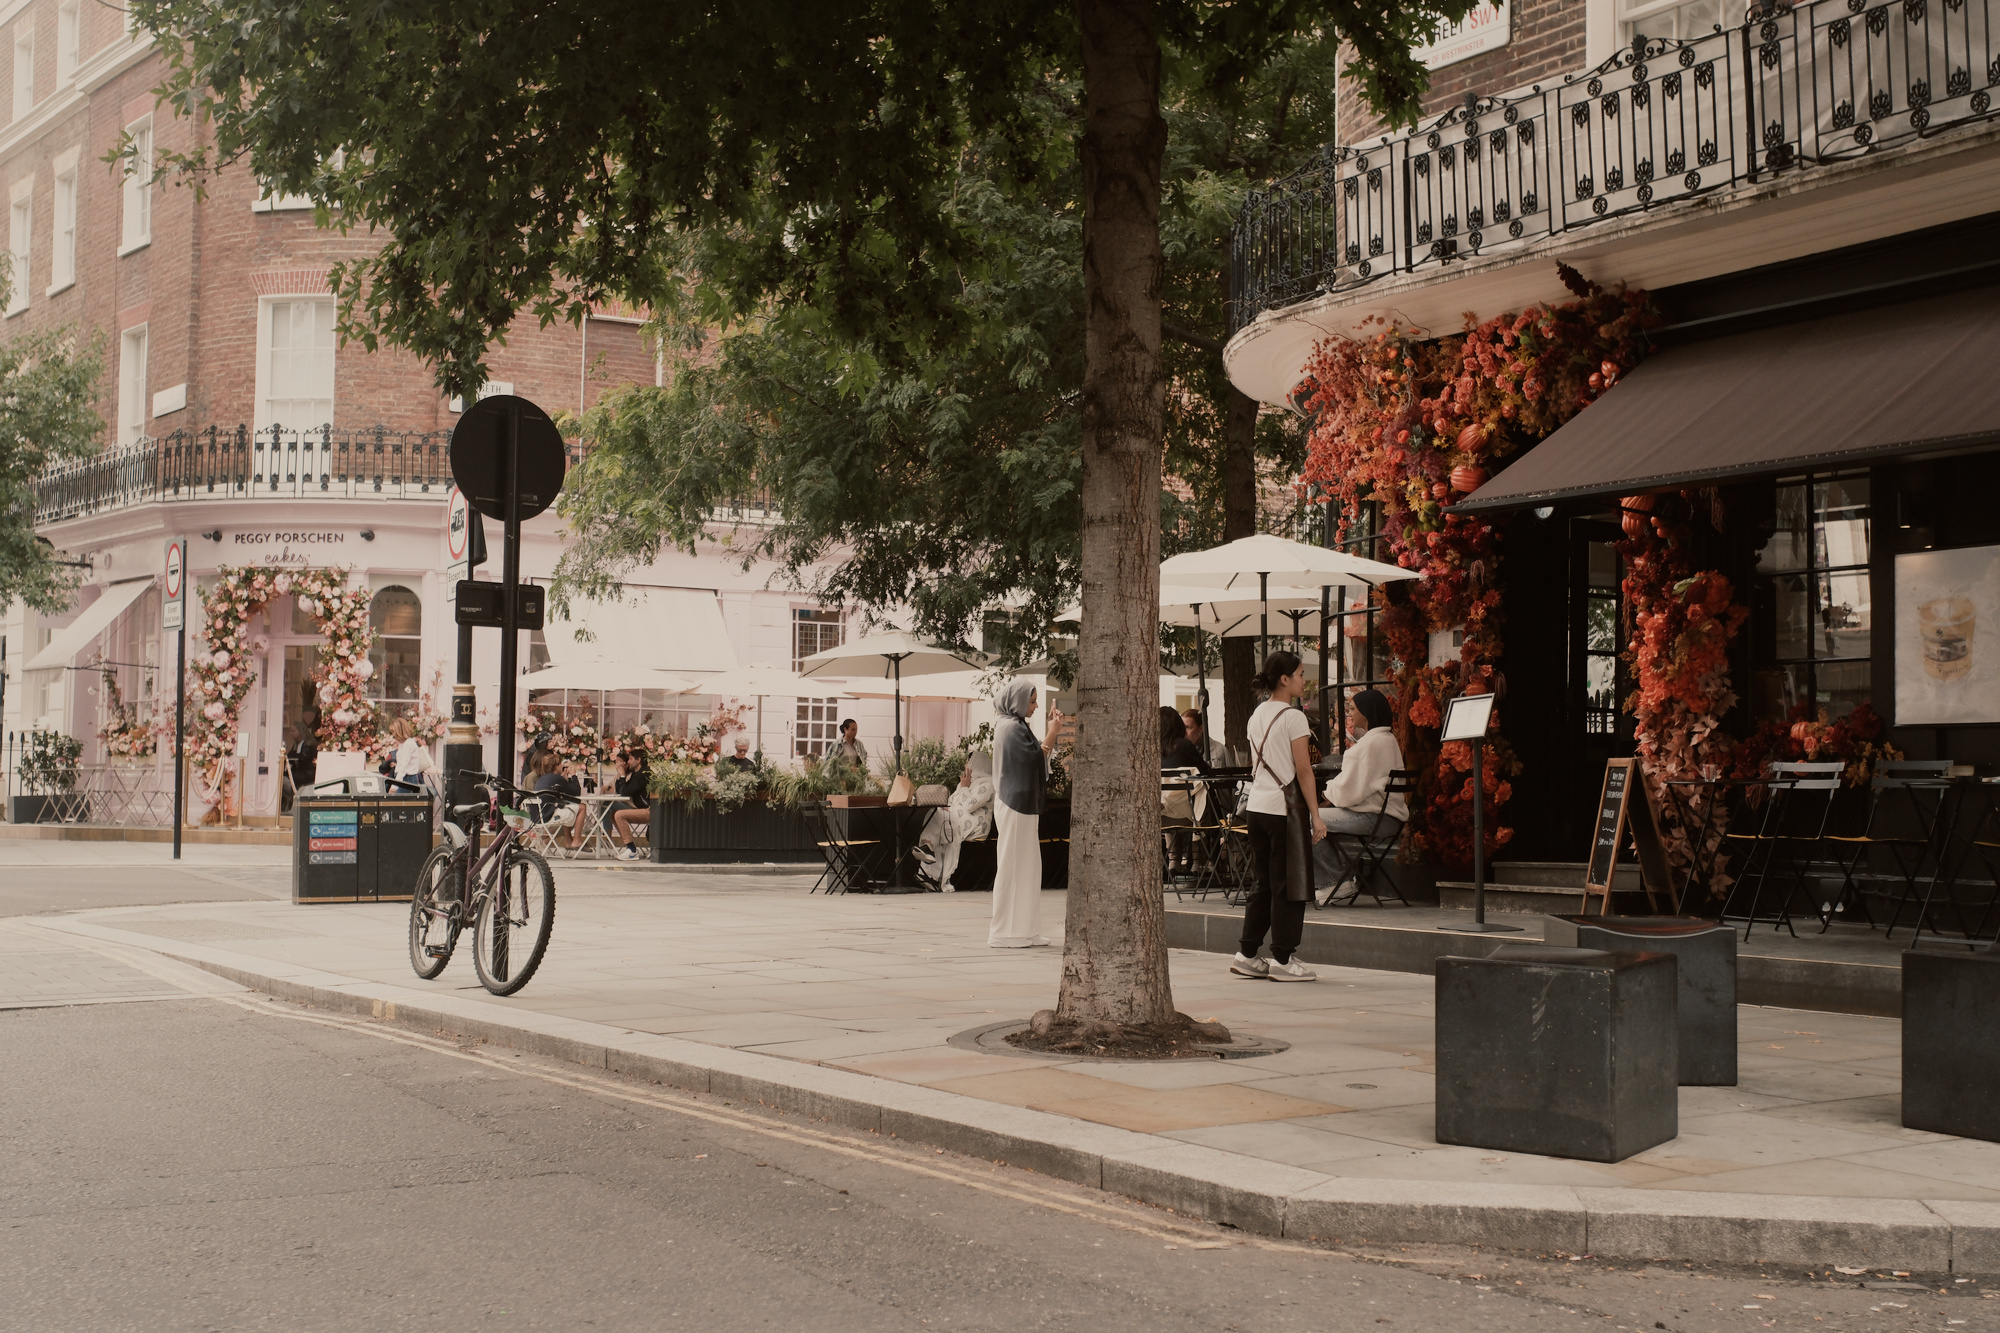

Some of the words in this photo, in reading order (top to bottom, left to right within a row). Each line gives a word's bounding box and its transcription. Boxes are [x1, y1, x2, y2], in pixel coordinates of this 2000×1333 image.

[1416, 19, 1463, 49] SREET
[1441, 38, 1485, 60] WESTMINSTER
[482, 384, 501, 394] BETH
[234, 533, 271, 544] PEGGY
[275, 532, 344, 544] PORSCHEN
[264, 546, 305, 565] cakes
